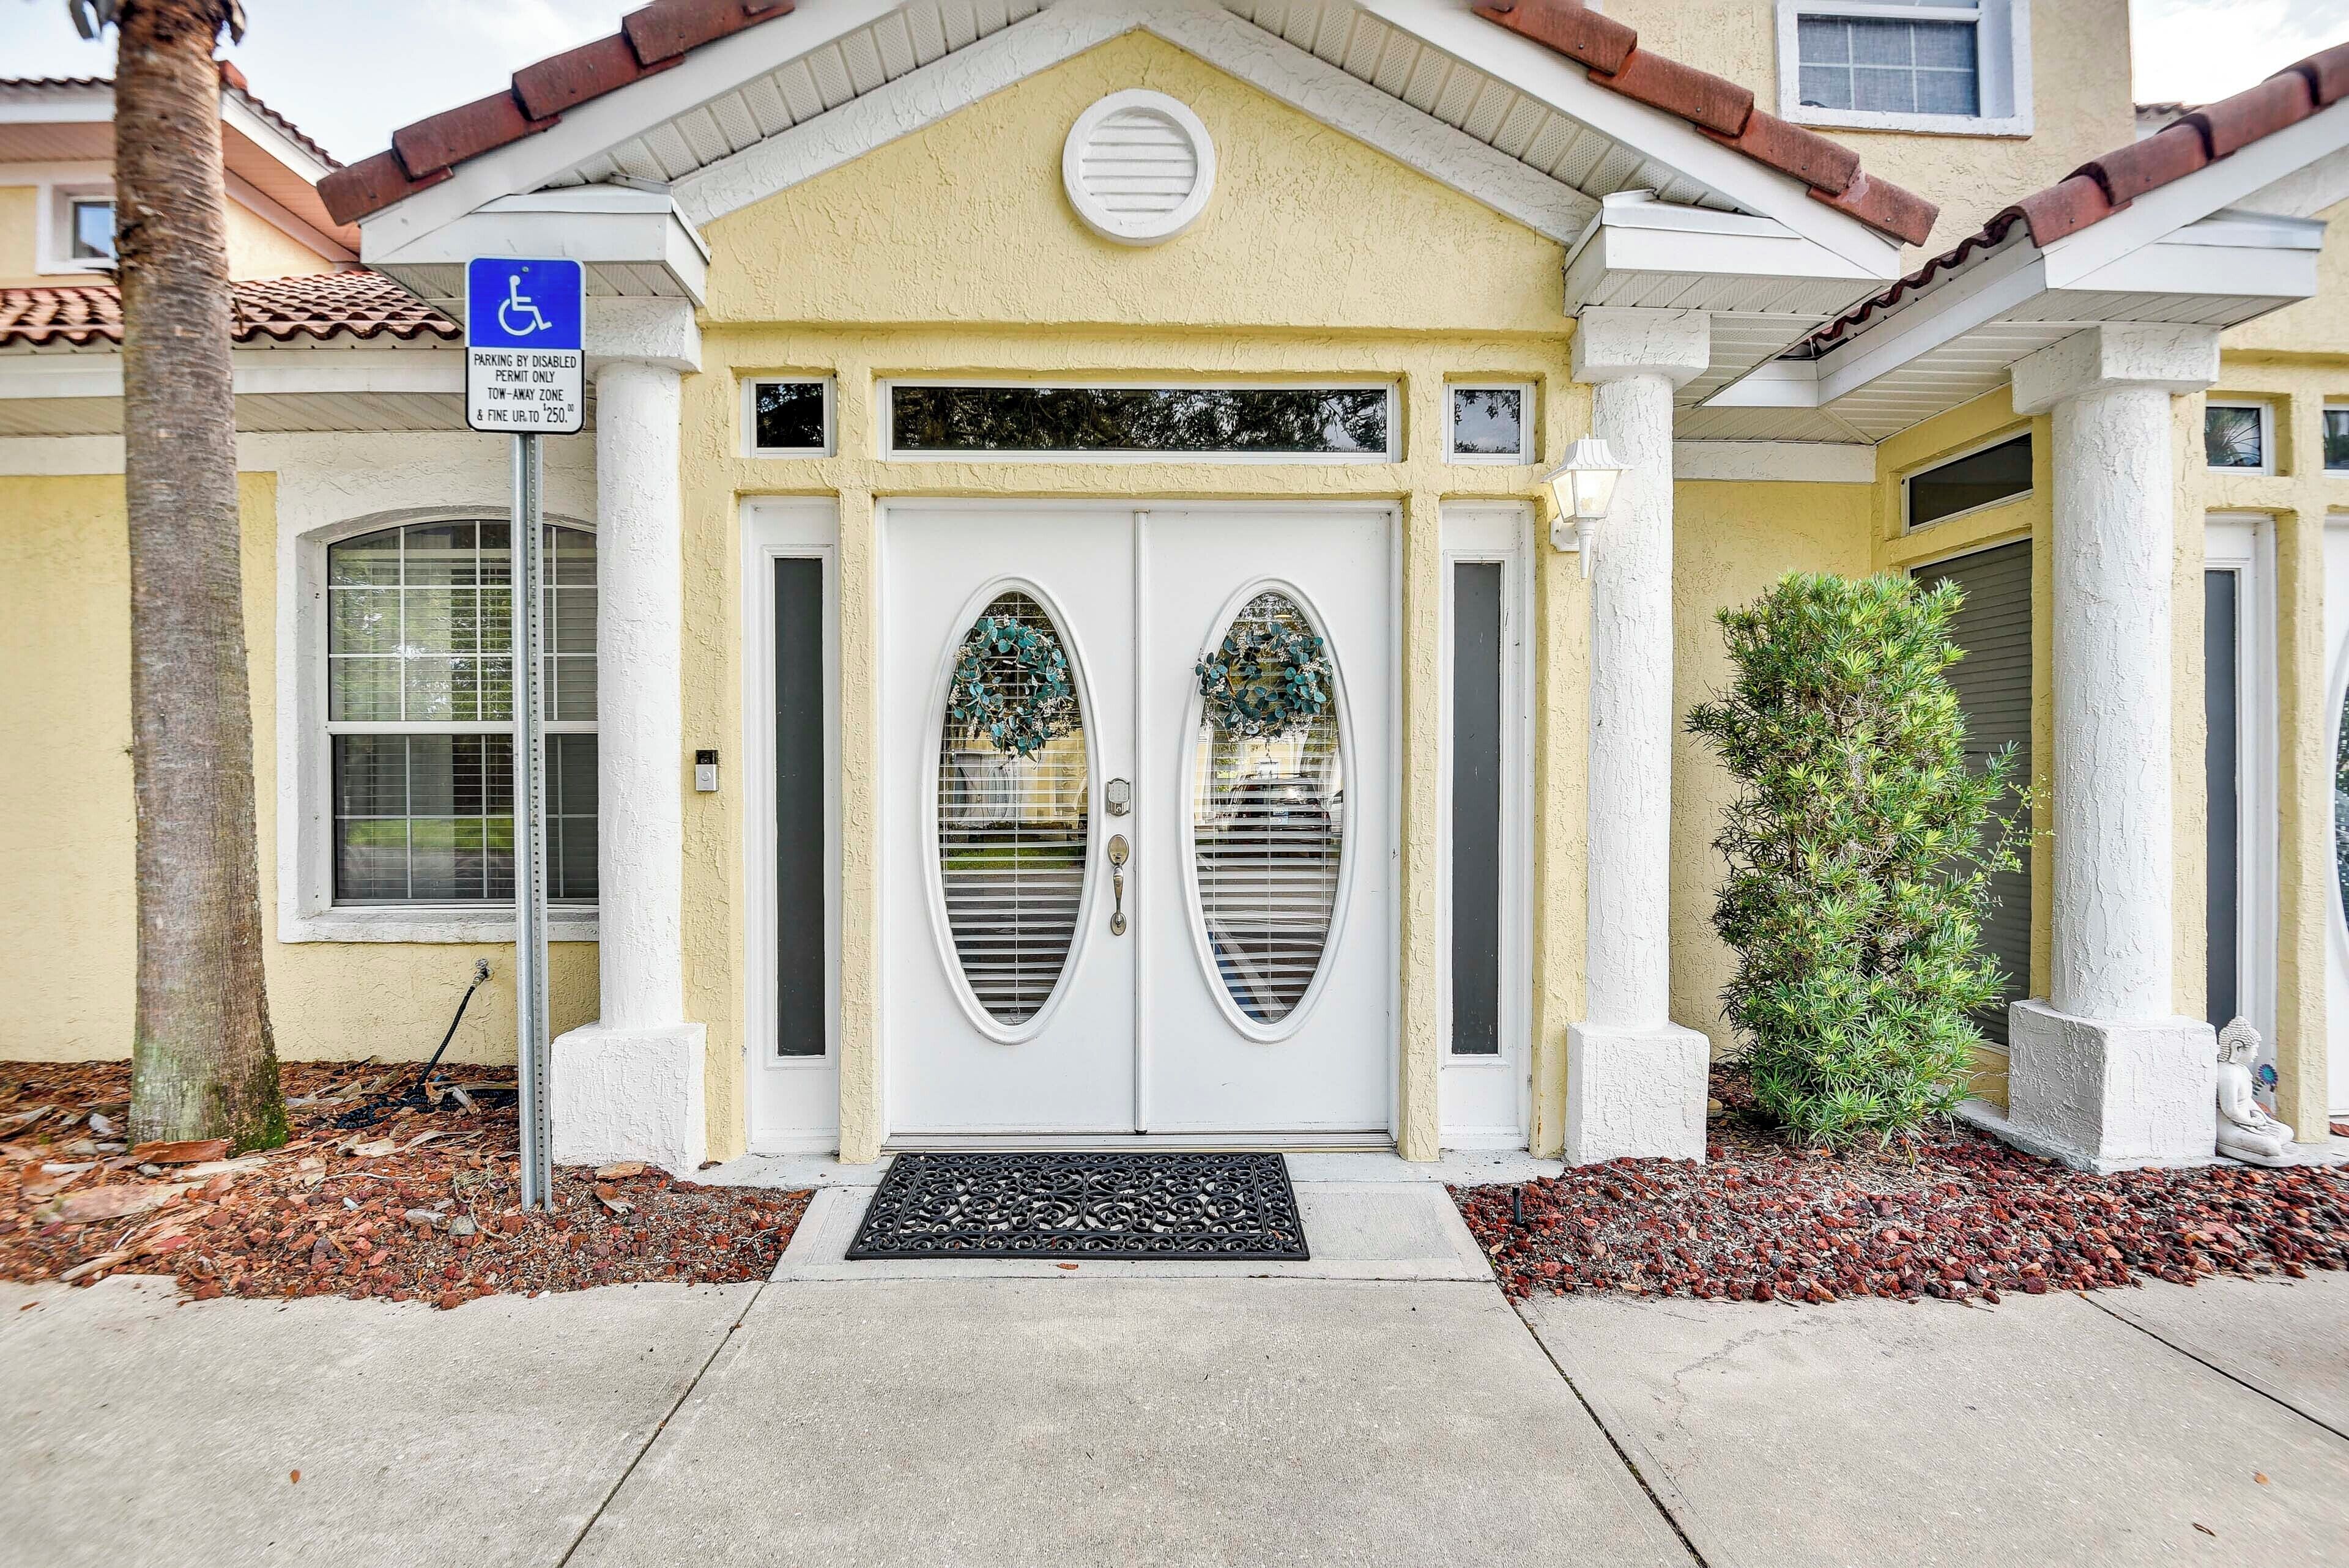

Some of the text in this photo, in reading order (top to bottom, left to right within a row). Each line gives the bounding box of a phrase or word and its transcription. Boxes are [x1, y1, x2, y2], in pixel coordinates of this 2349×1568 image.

[474, 353, 576, 368] PARKING BY DISABLED
[495, 370, 555, 383] PERMIT ONLY
[488, 387, 564, 401] TOW-AWAY ZONE
[477, 409, 483, 421] &
[488, 409, 508, 421] FINE
[513, 410, 525, 422] UP
[529, 410, 539, 423] TO
